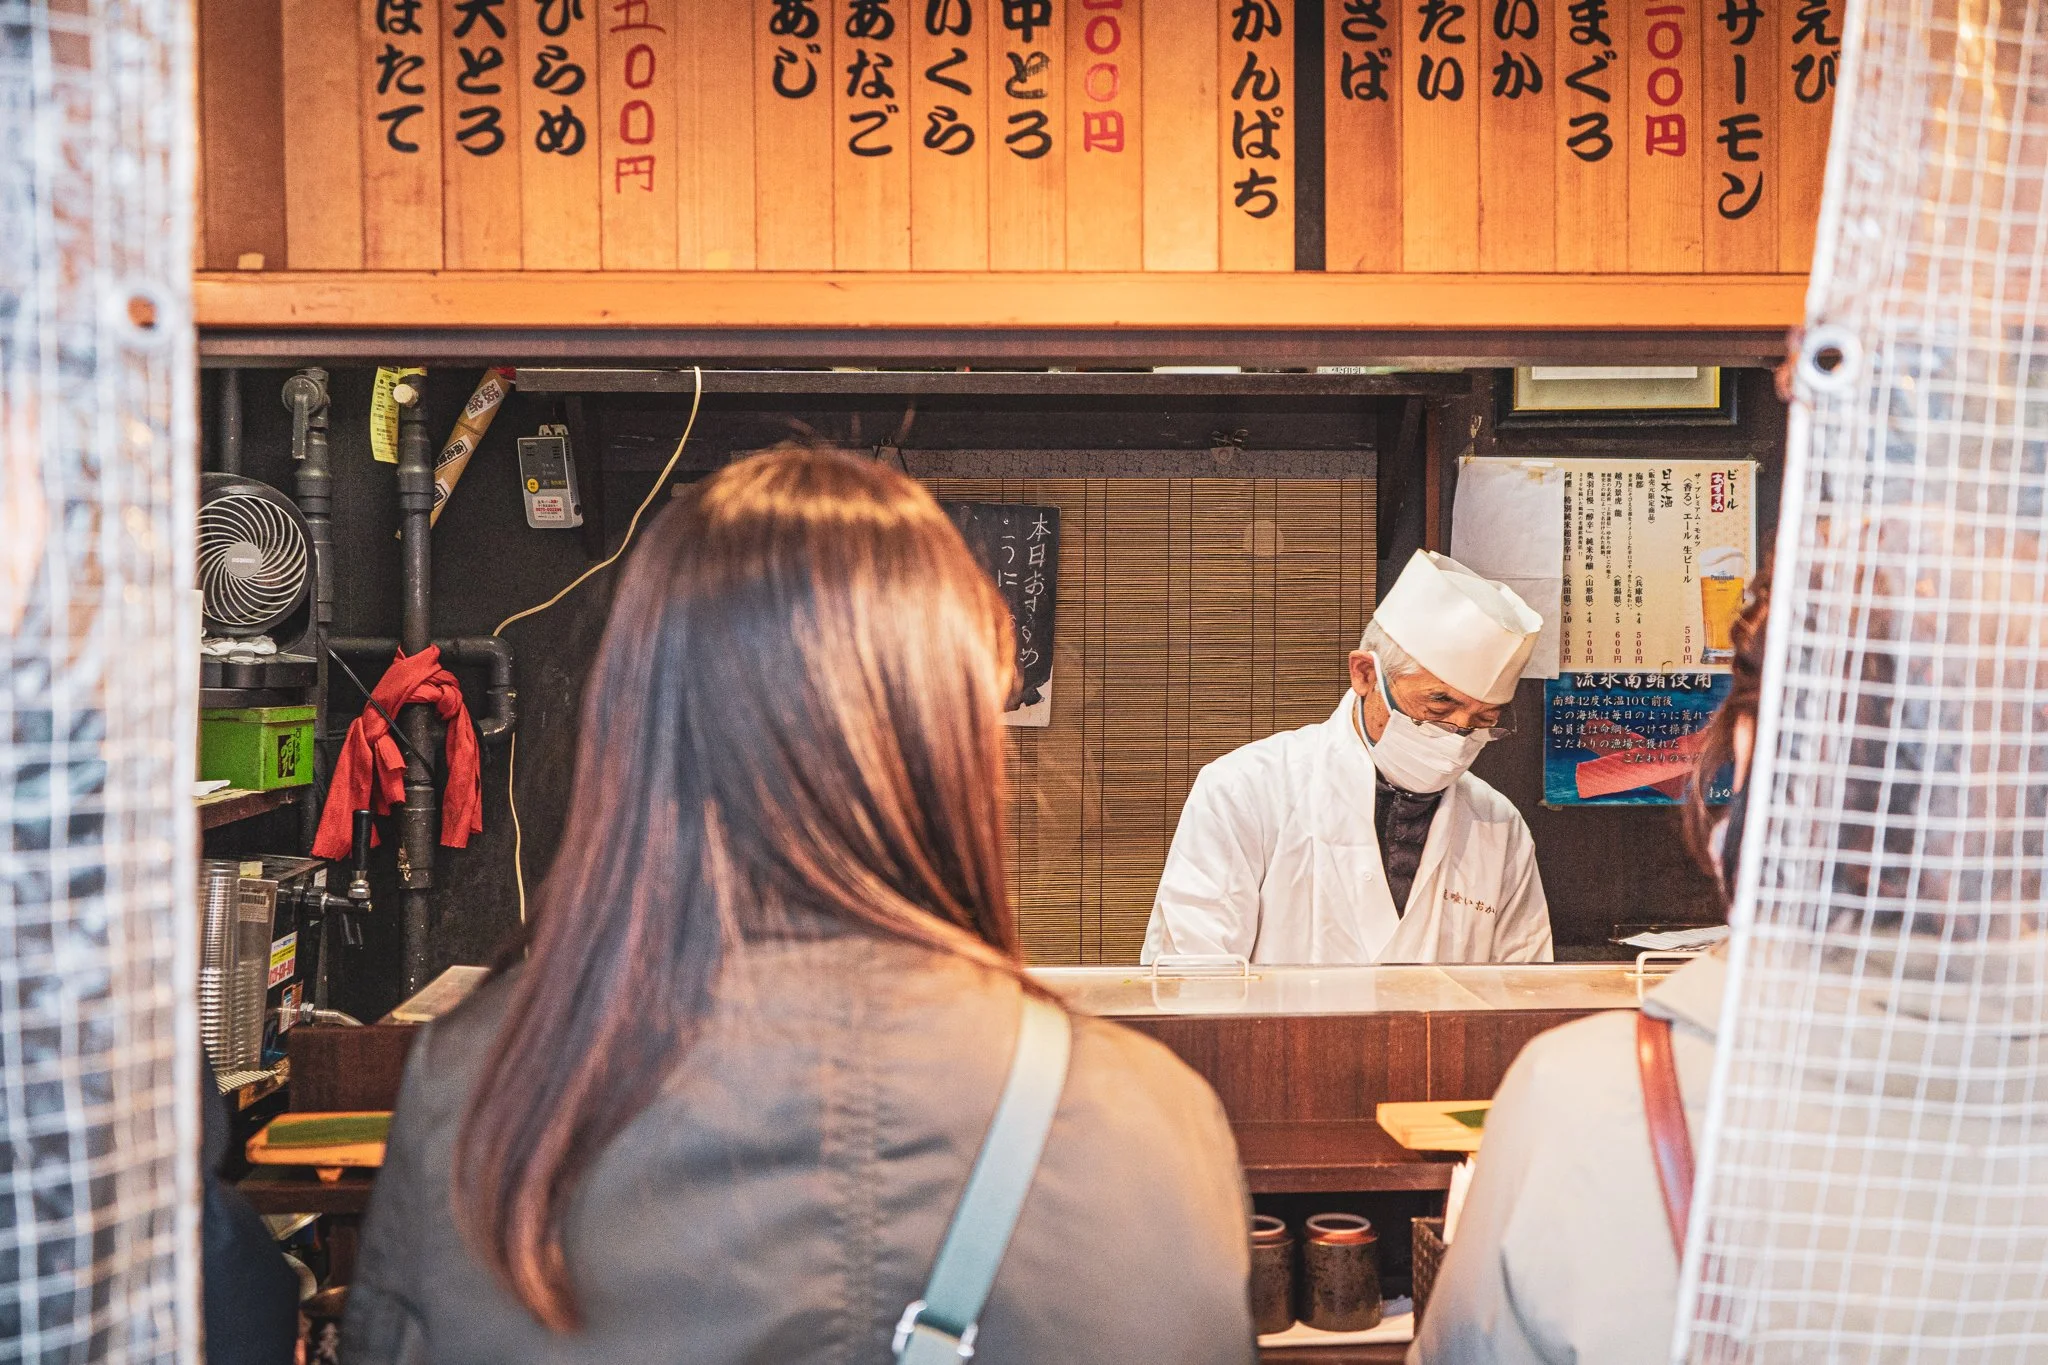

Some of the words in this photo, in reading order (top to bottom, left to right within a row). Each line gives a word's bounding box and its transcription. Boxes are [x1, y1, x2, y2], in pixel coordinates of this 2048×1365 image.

[376, 0, 425, 153] ほたて
[453, 0, 508, 157] 大とろ
[534, 0, 586, 156] ひらめ
[770, 0, 822, 99] あじ
[845, 0, 899, 157] あなご
[924, 0, 975, 156] いくら
[1001, 0, 1053, 159] 中とろ
[1083, 0, 1125, 153] 〇〇円
[1341, 0, 1392, 102] さば
[1417, 0, 1466, 102] たい
[1492, 0, 1543, 99] いか
[1565, 0, 1618, 162] まぐろ
[1791, 0, 1841, 104] えび
[1232, 0, 1284, 218] かんぱち
[1717, 0, 1764, 219] サーモン
[1660, 468, 1674, 509] 日本酒
[1683, 513, 1693, 540] エール
[1711, 472, 1724, 512] おすすめ
[1727, 468, 1739, 510] ビール
[1683, 545, 1693, 584] 生ビール
[1563, 631, 1572, 664] 800円
[1586, 631, 1594, 664] 700円
[1613, 631, 1622, 664] 600円
[1634, 632, 1643, 664] 500円
[1683, 626, 1693, 665] 550円
